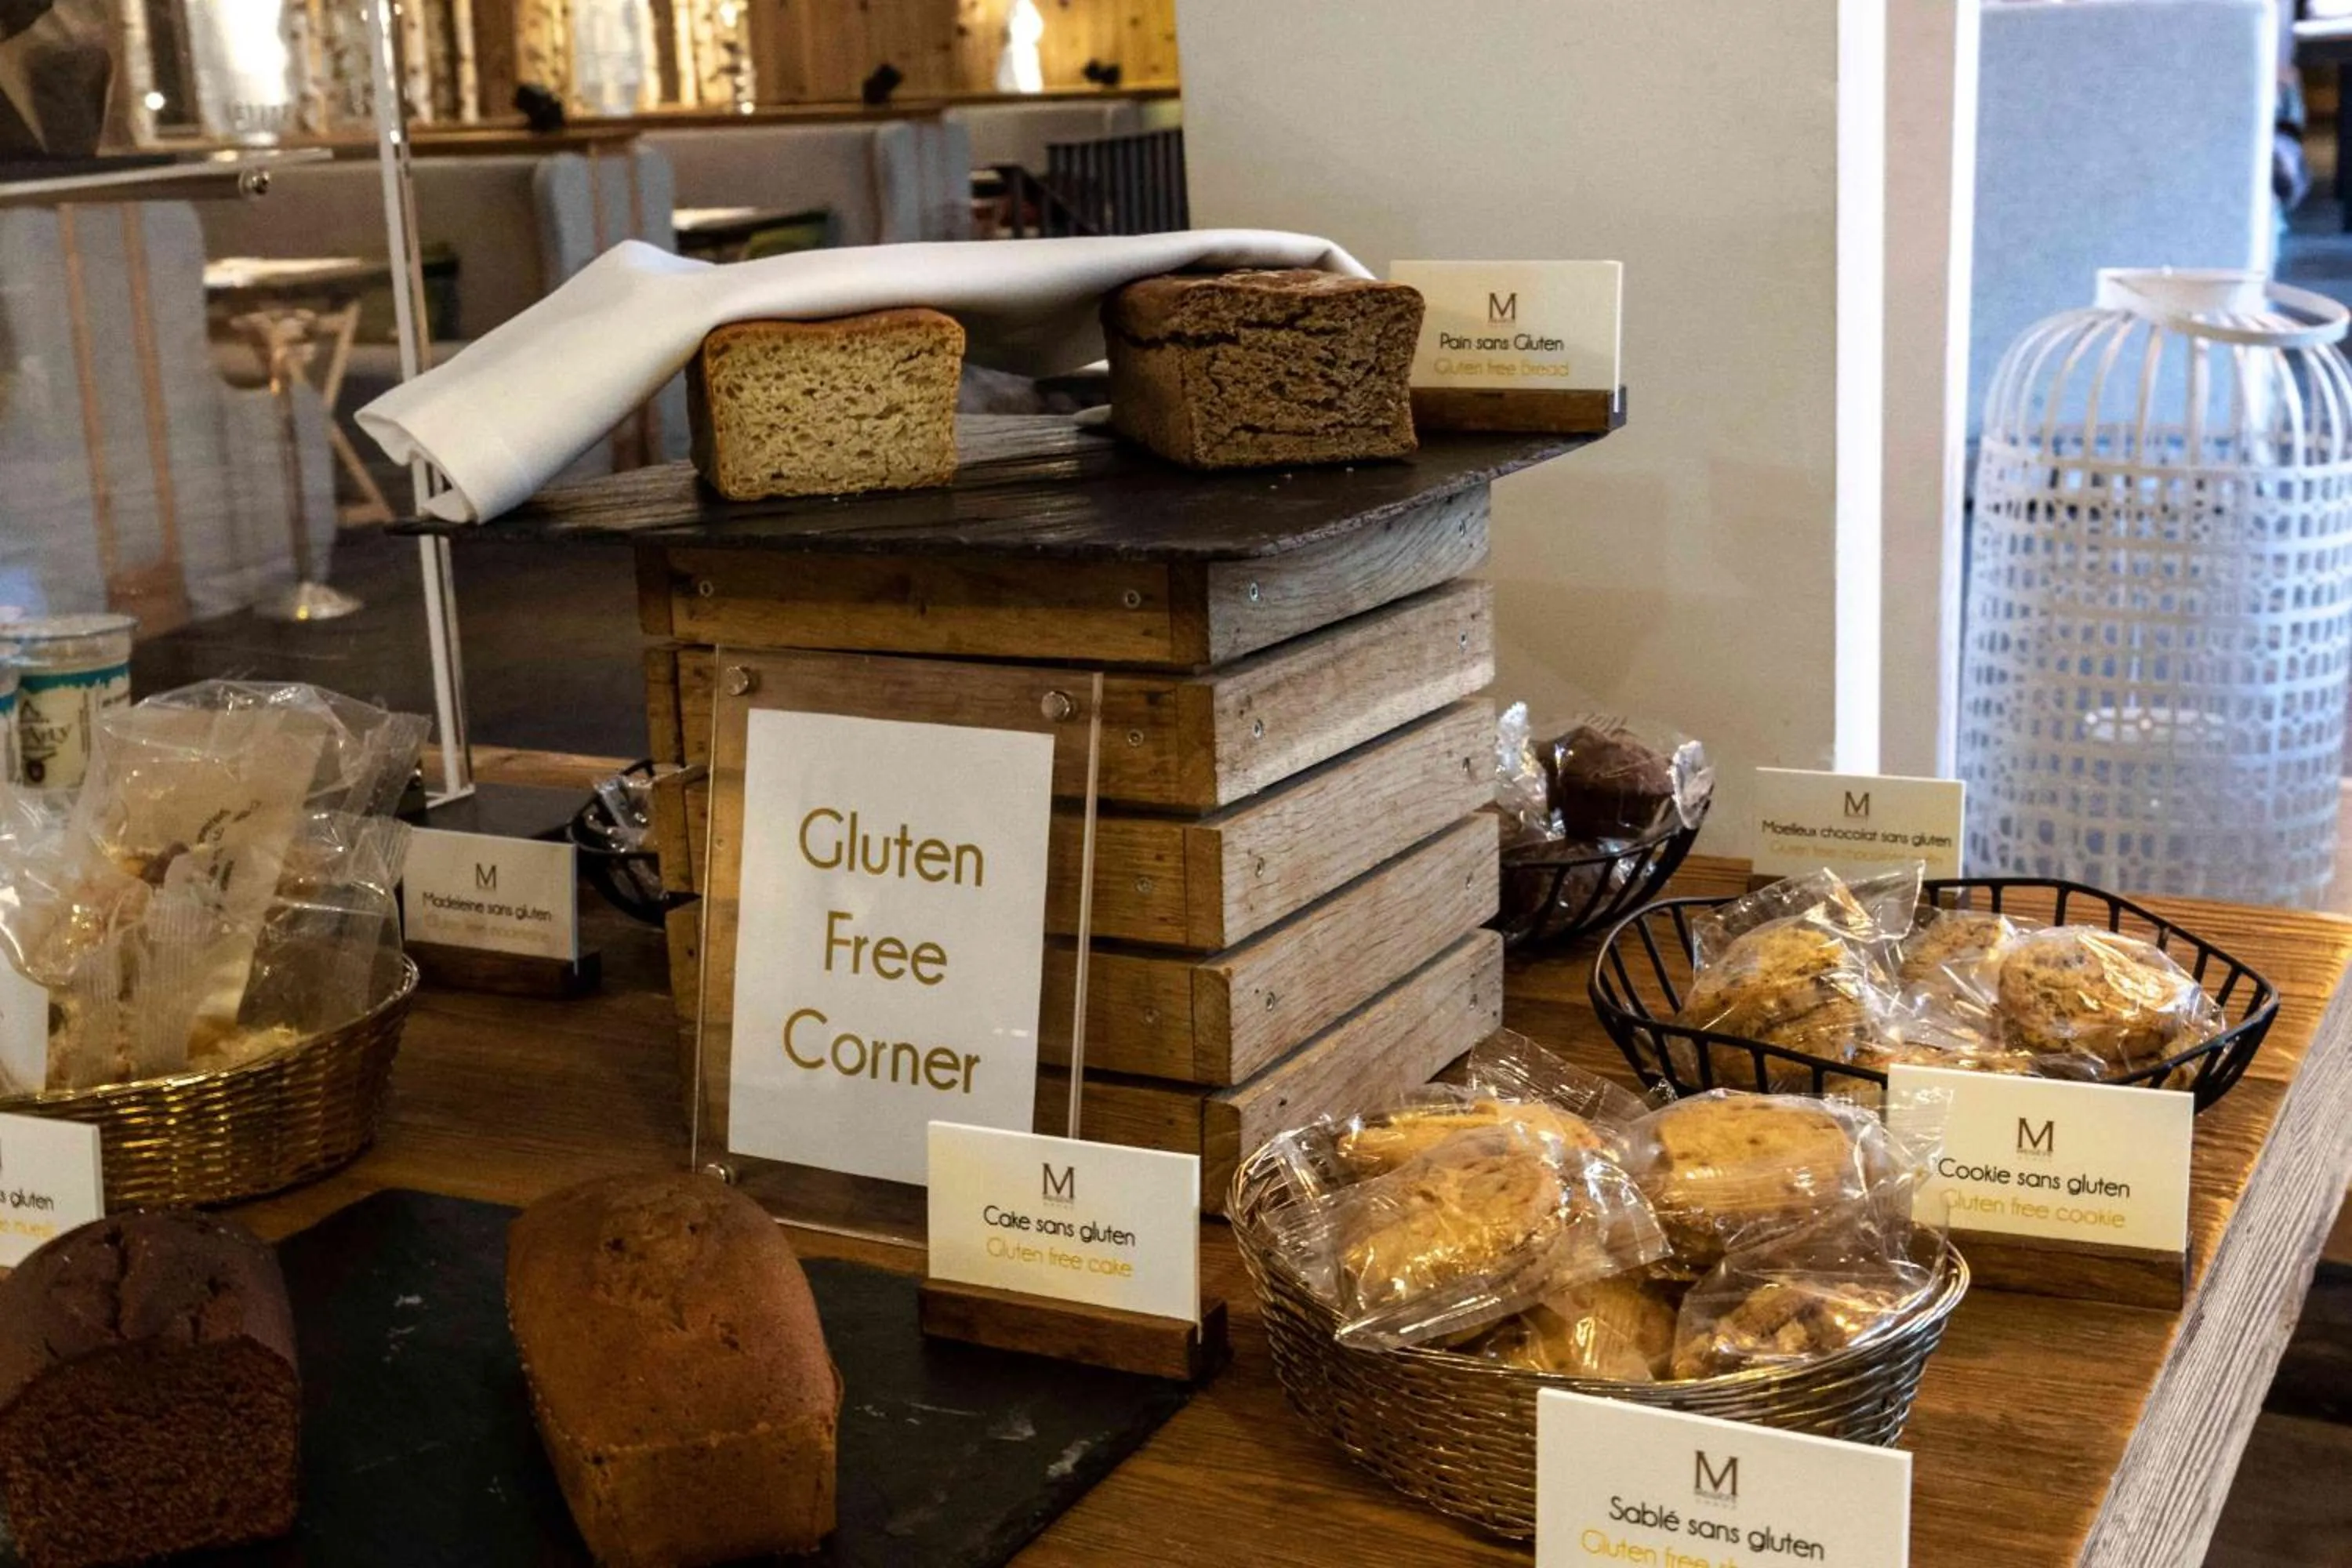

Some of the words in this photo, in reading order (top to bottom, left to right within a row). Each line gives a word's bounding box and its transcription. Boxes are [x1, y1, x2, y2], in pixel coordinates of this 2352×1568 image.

[1489, 292, 1517, 320] M
[1439, 332, 1472, 350] Pain
[1476, 336, 1509, 350] sans
[1843, 791, 1871, 817] M
[798, 807, 985, 887] Gluten
[1882, 829, 1908, 845] sans
[1911, 832, 1952, 848] gluten
[475, 862, 497, 890] M
[823, 909, 949, 985] Free
[783, 1007, 982, 1094] Corner
[2016, 1116, 2055, 1152] M
[1042, 1162, 1076, 1200] M
[1937, 1156, 2011, 1185] Cookie
[2017, 1171, 2061, 1191] sans
[2067, 1173, 2131, 1200] gluten
[9, 1188, 55, 1212] gluten
[1940, 1188, 2005, 1217] Gluten
[2009, 1196, 2050, 1220] free
[2055, 1203, 2126, 1229] cookie
[983, 1204, 1032, 1230] Cake
[1035, 1215, 1075, 1238] sans
[1079, 1221, 1136, 1247] gluten
[985, 1236, 1044, 1265] Gluten
[1047, 1247, 1083, 1271] free
[1087, 1254, 1134, 1279] cake
[1694, 1450, 1738, 1496] M
[1581, 1528, 1657, 1566] Gluten
[1608, 1494, 1680, 1532] Sablé
[1687, 1519, 1740, 1544] sans
[1747, 1527, 1824, 1561] gluten
